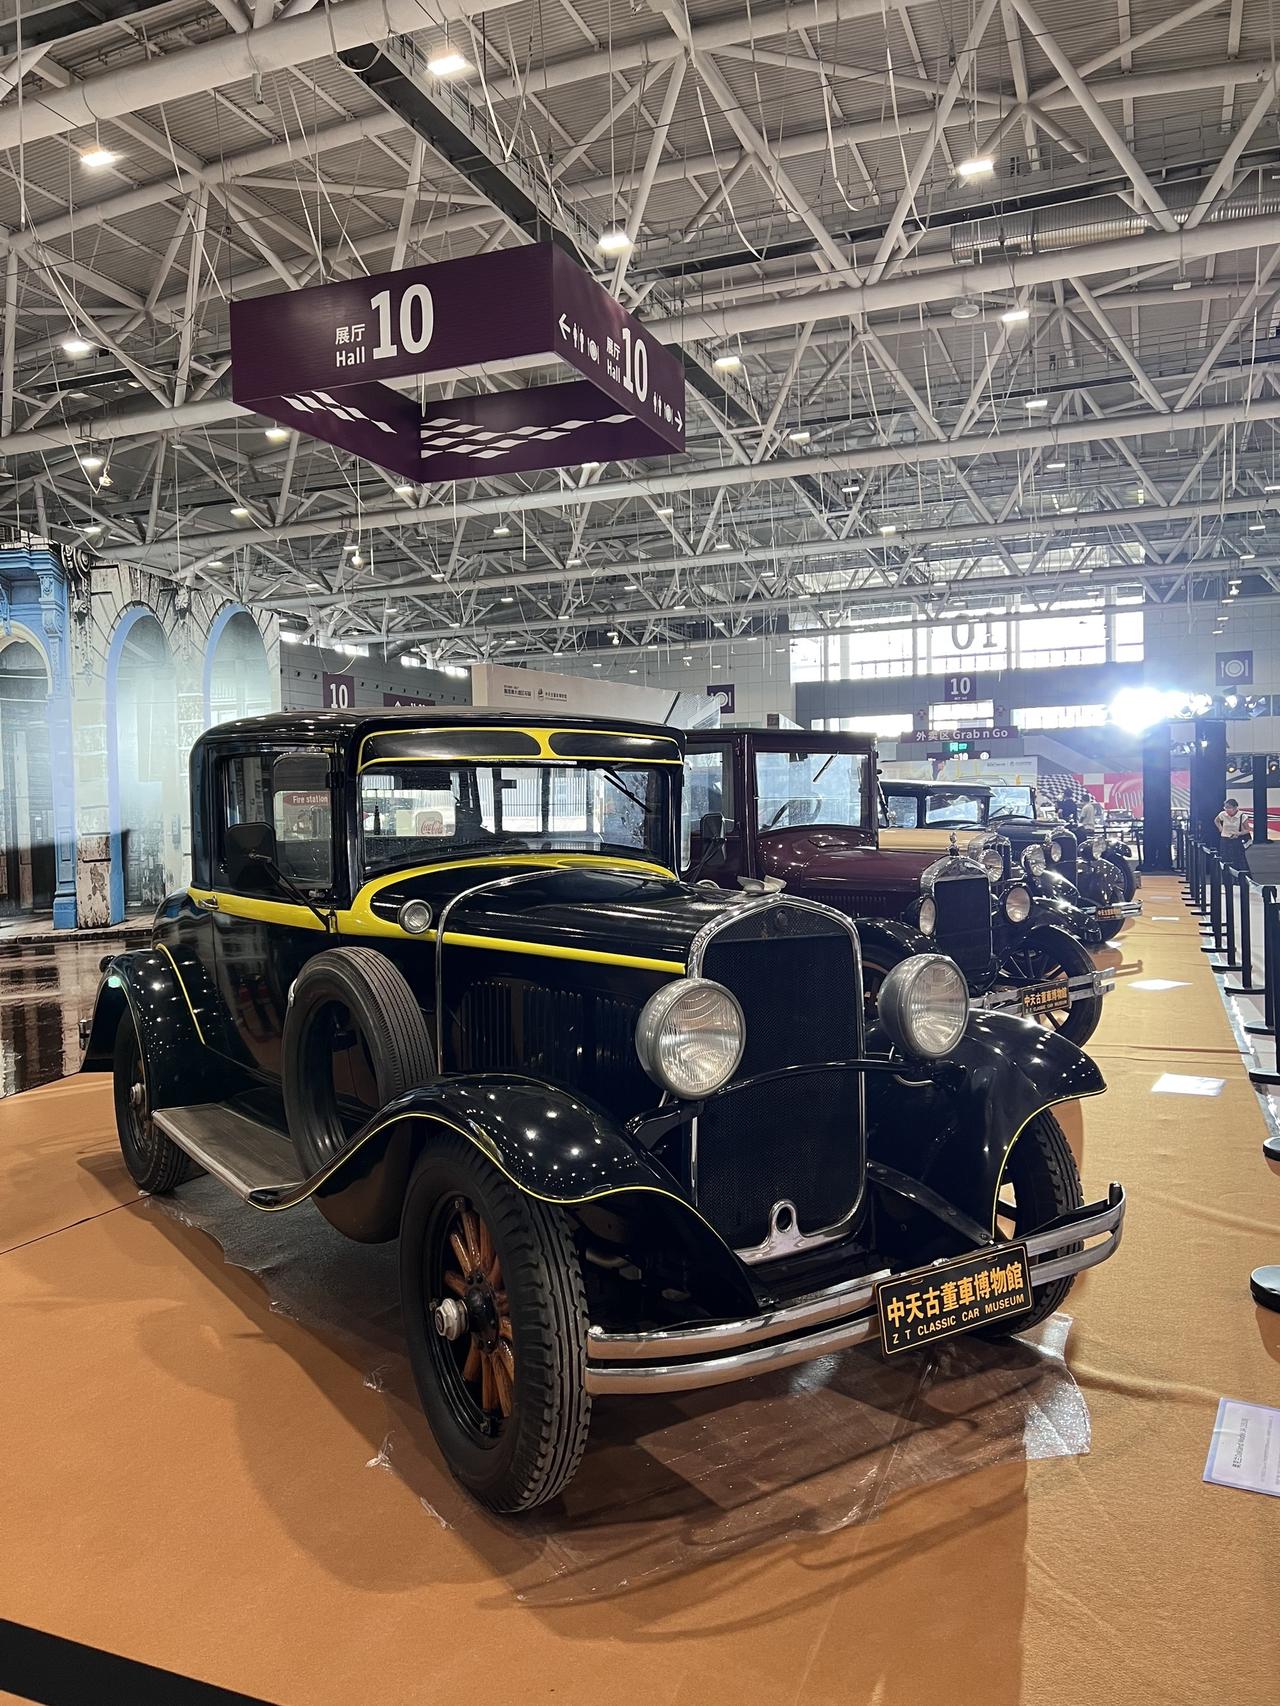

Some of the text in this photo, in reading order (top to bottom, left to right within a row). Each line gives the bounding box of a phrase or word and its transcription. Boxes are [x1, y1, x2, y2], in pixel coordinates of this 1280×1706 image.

[335, 323, 366, 345] 展厅
[371, 283, 434, 360] 10
[336, 345, 366, 367] Hall
[606, 335, 620, 361] 展厅
[607, 358, 621, 384] Hall
[622, 327, 648, 403] 10
[330, 683, 349, 708] 10
[950, 677, 971, 695] 10
[916, 728, 1008, 741] 外卖区 Grab n Go
[292, 794, 329, 804] Fire station
[887, 1261, 1024, 1328] 中天古董車博物館
[892, 1293, 1025, 1345] Z T CLASSIC CAR MUSEUM
